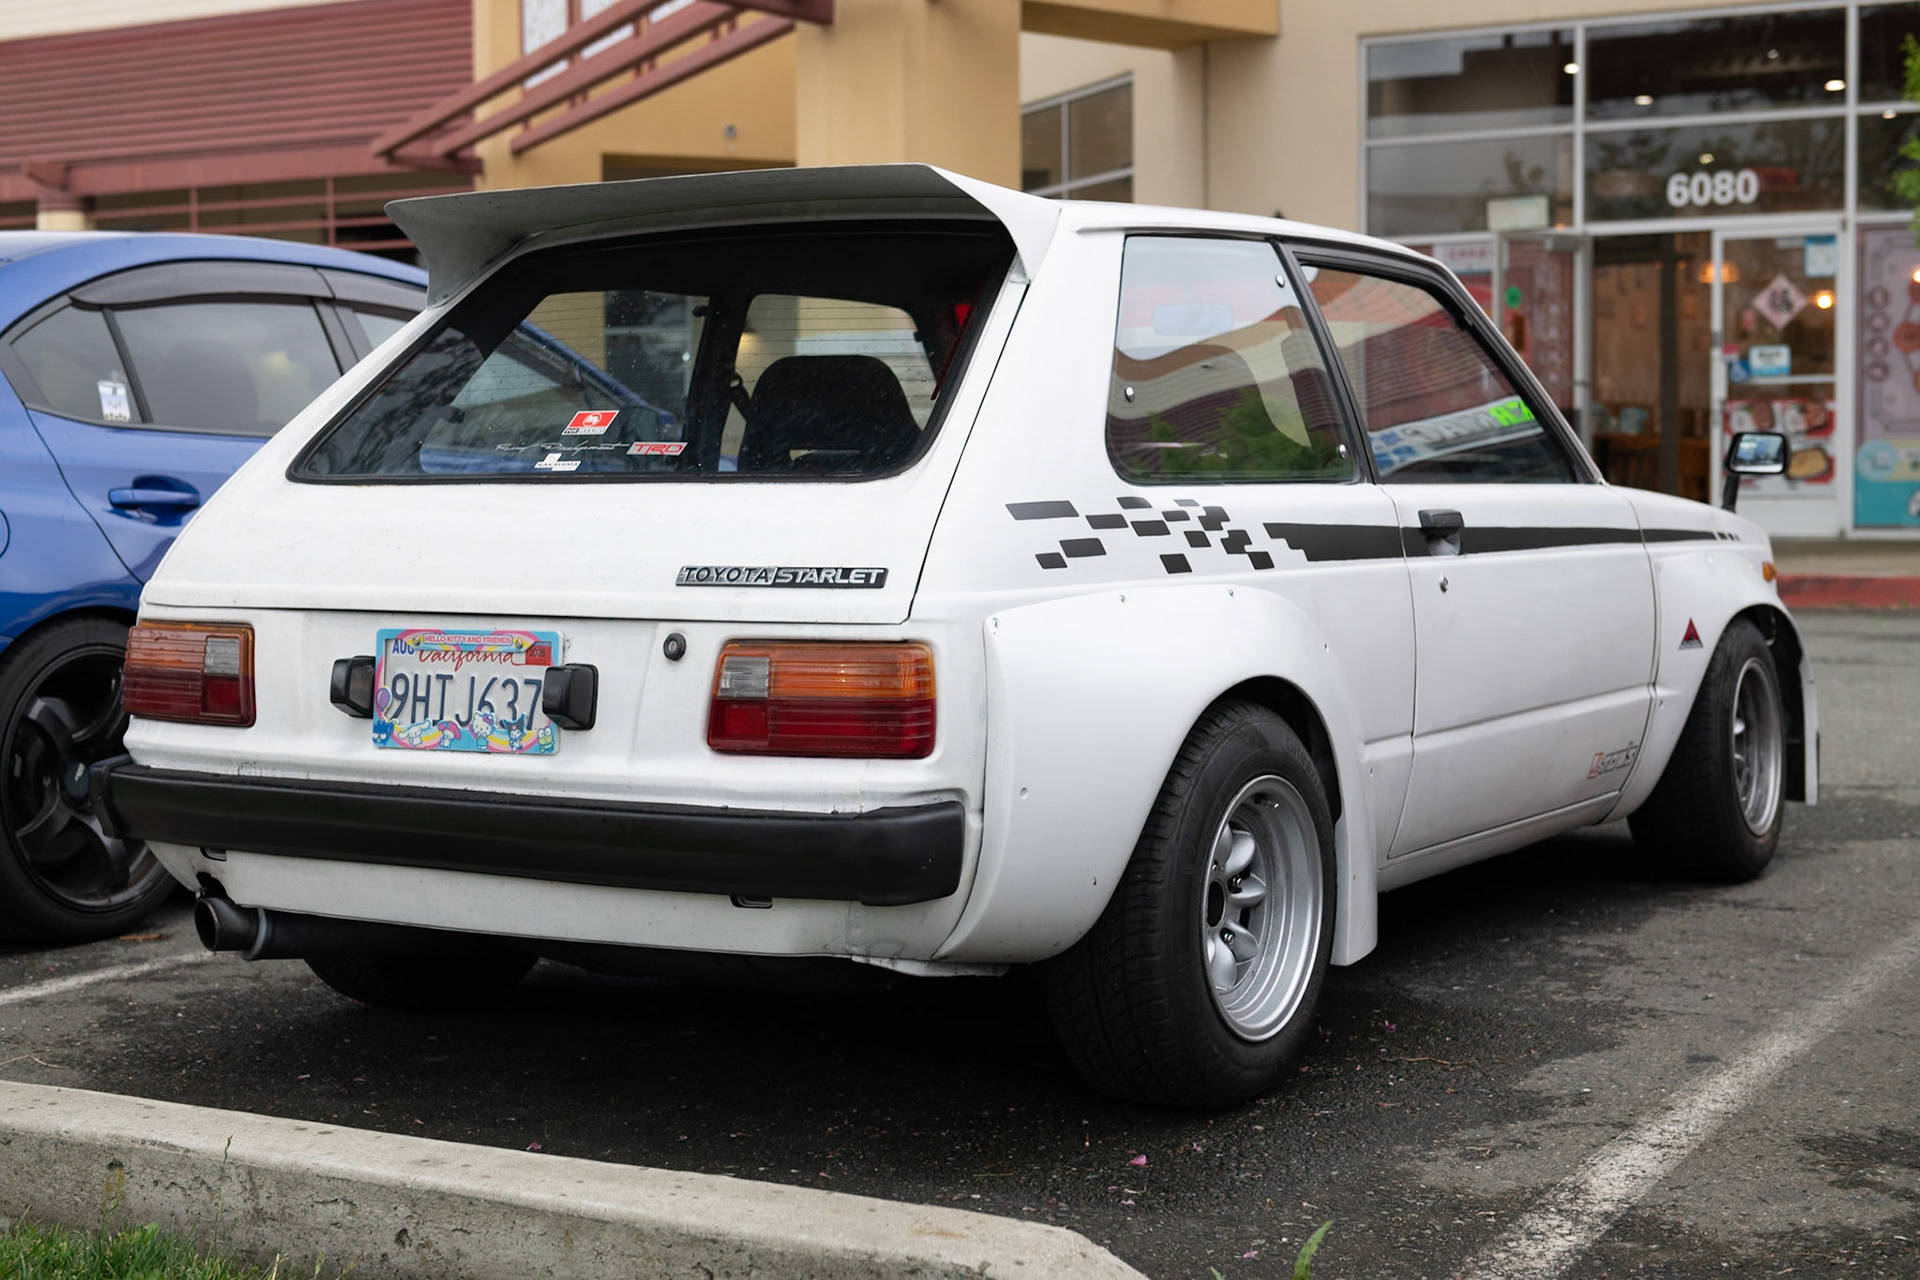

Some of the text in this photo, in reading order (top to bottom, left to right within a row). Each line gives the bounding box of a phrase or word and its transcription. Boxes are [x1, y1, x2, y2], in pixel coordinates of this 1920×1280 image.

[1666, 169, 1759, 207] 6080
[634, 443, 684, 455] TRD
[682, 567, 884, 584] TOYOTA STARLET
[392, 639, 415, 655] AUG
[424, 635, 512, 645] HELLO KITTY AND FRIENDS
